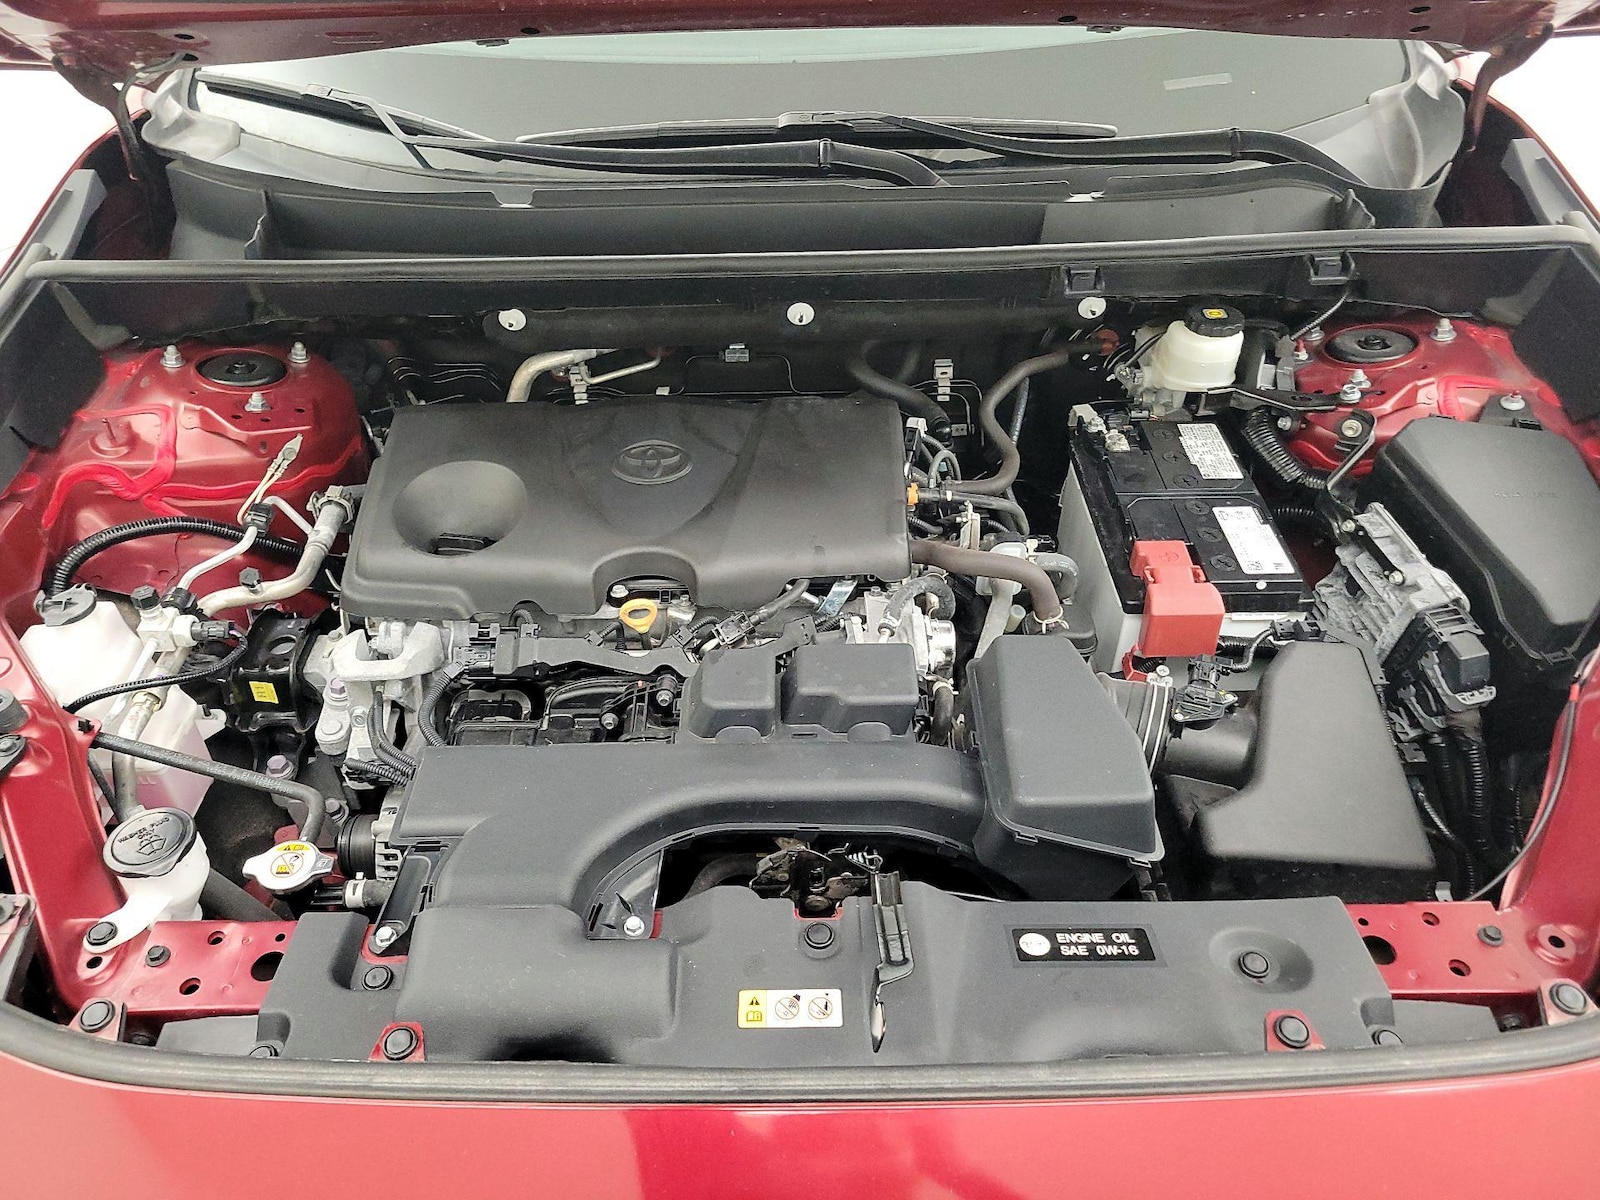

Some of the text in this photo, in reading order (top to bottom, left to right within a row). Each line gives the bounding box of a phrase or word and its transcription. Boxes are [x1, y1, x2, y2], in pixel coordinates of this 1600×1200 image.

[1055, 932, 1136, 944] ENGINE OIL
[1060, 945, 1140, 956] SAE 0W-16
